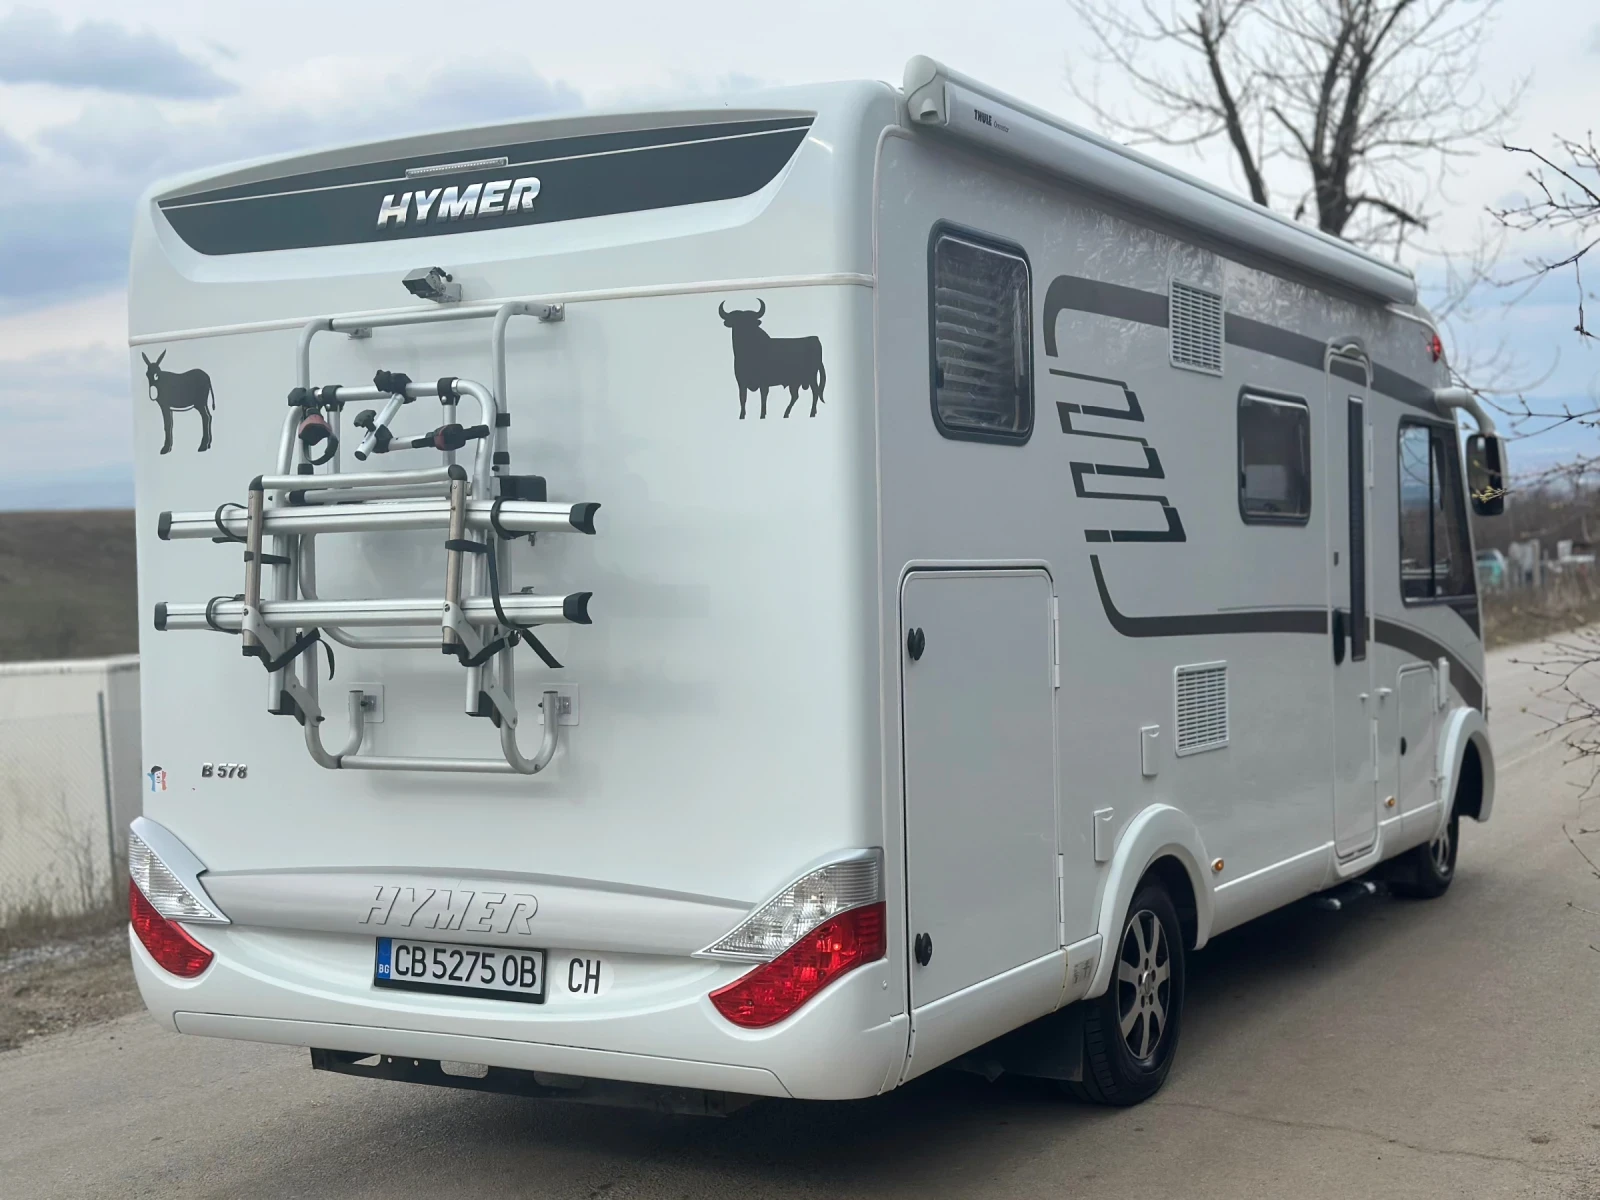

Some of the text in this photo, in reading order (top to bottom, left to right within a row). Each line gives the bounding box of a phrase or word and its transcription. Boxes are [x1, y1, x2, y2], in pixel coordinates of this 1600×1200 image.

[376, 177, 541, 230] HYMER
[201, 762, 248, 779] B 578
[358, 886, 539, 935] HYMER
[378, 963, 390, 974] BG
[394, 945, 427, 977] CB
[432, 948, 496, 984] 5275
[568, 957, 601, 994] CH
